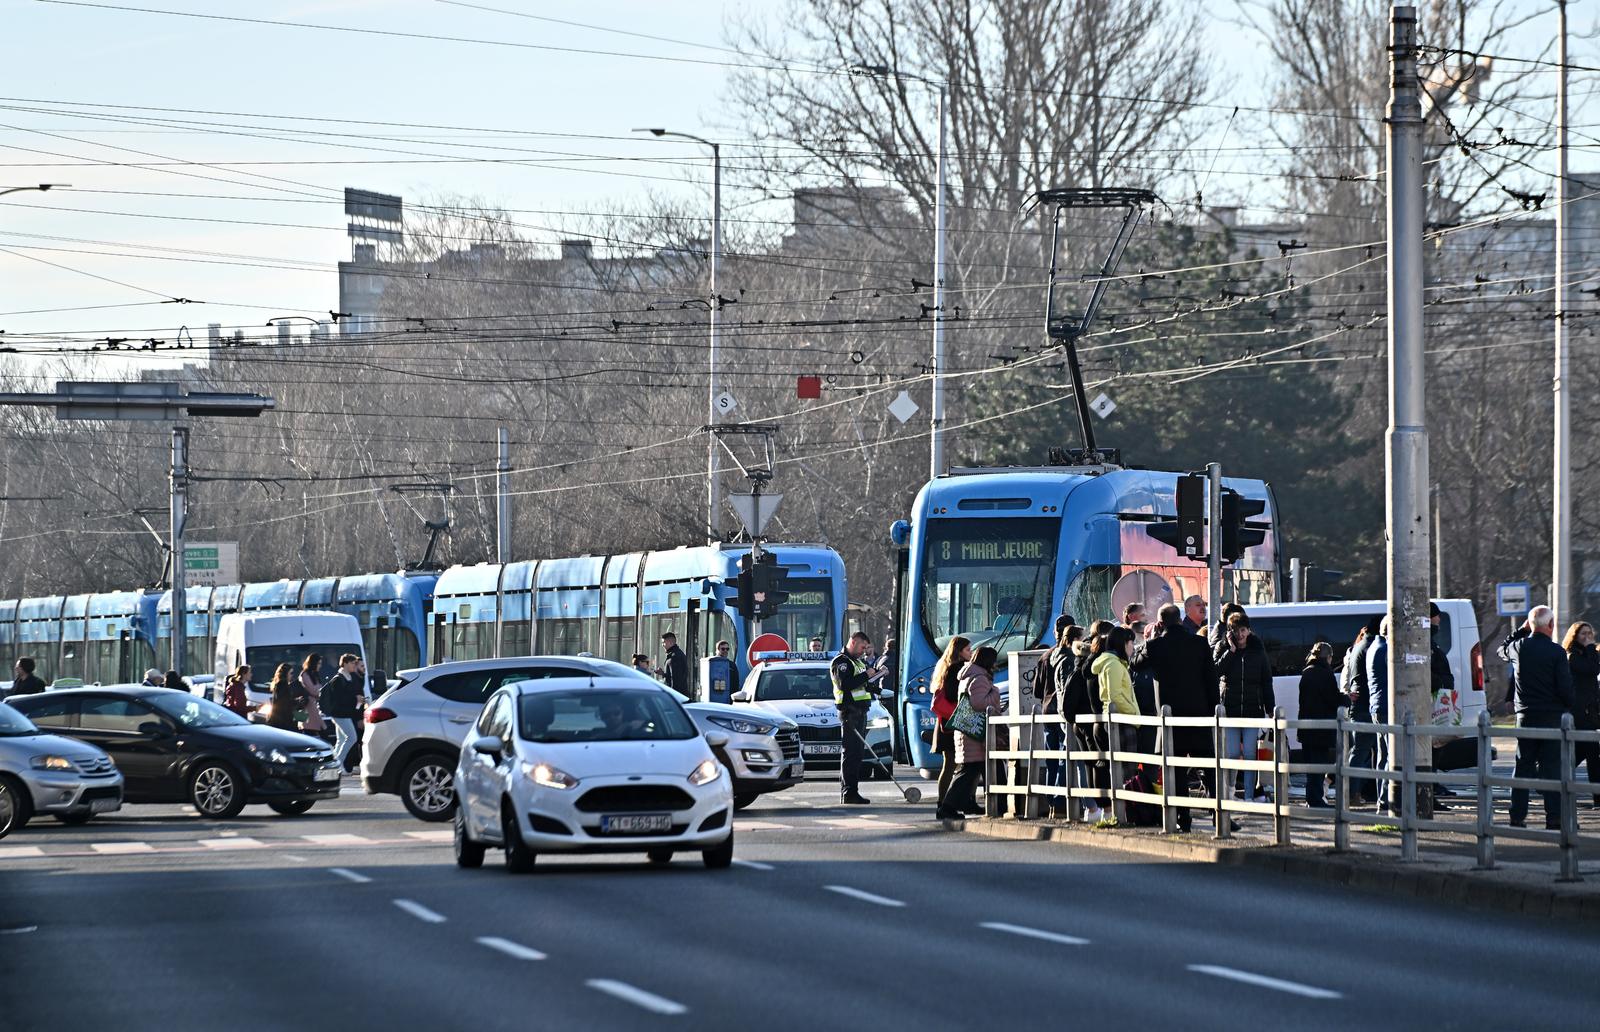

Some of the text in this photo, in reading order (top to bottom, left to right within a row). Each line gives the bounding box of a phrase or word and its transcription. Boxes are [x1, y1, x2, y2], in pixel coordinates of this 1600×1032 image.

[720, 398, 728, 407] S
[942, 541, 1043, 560] 8 MIHALJEVAC
